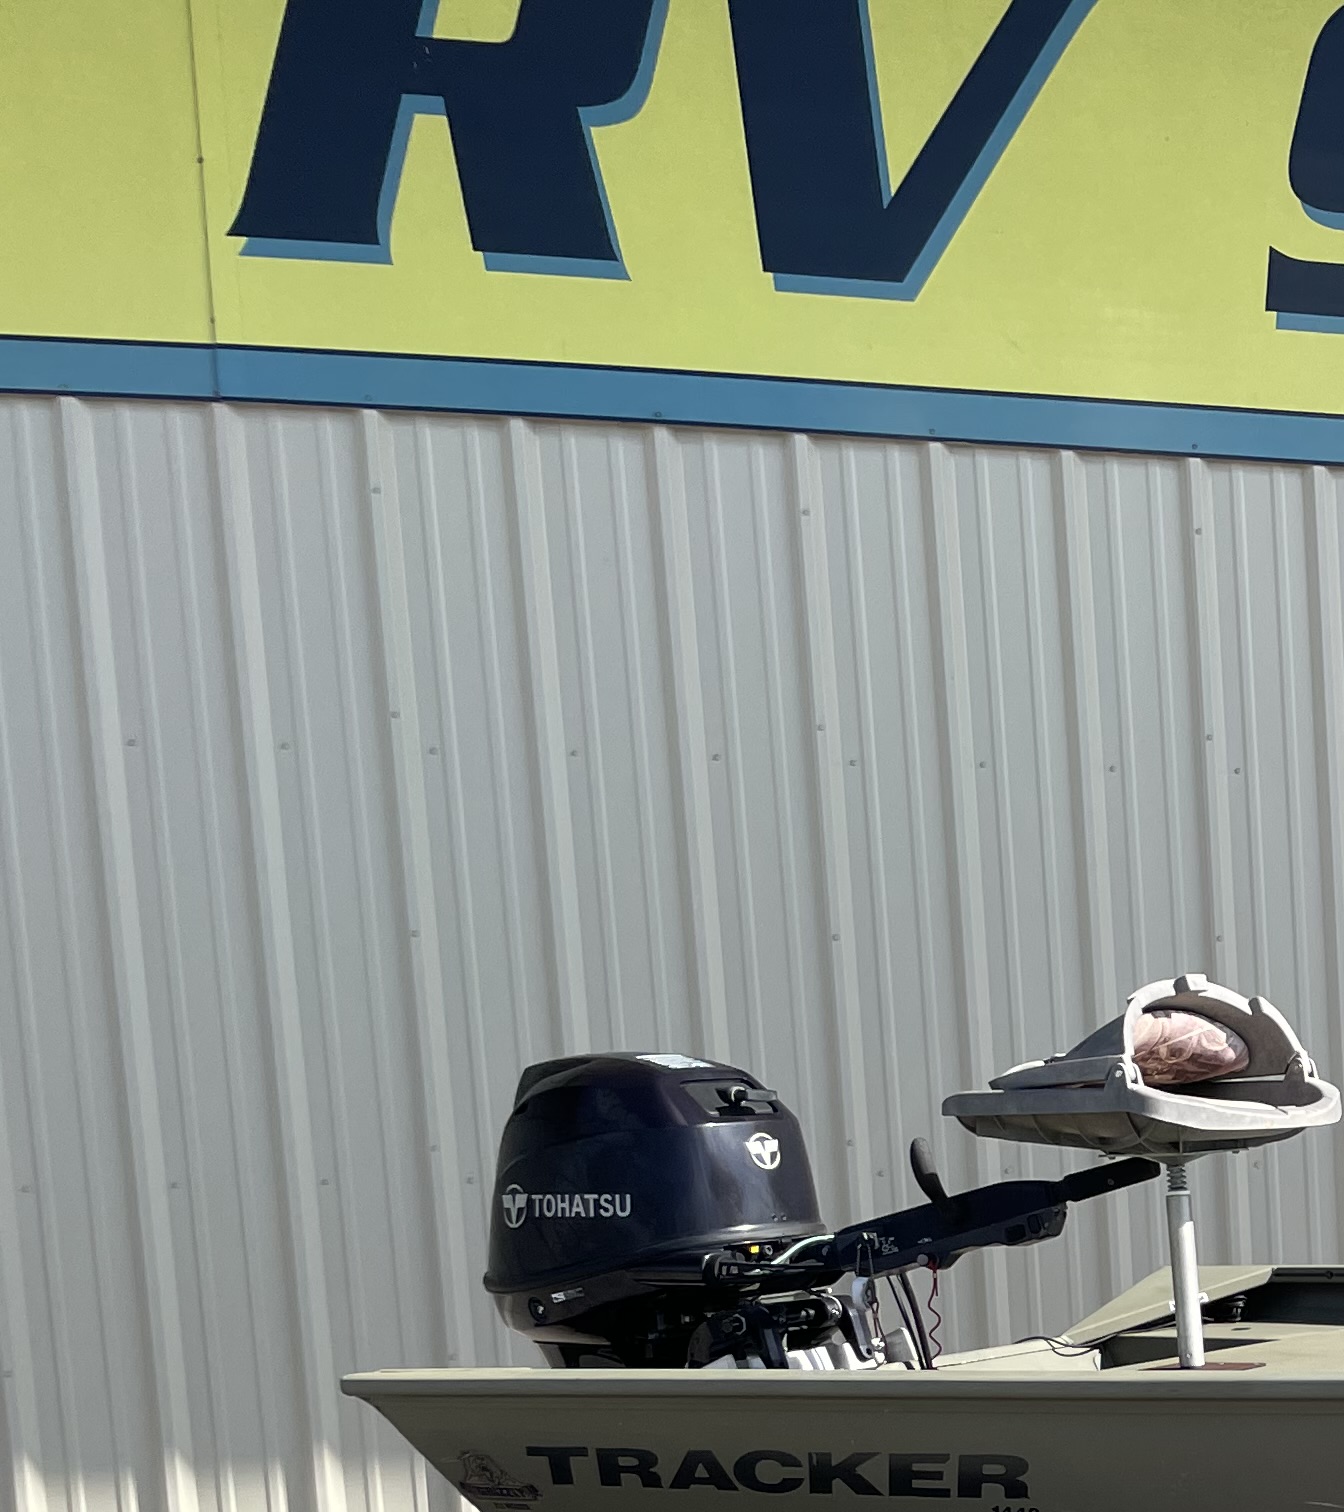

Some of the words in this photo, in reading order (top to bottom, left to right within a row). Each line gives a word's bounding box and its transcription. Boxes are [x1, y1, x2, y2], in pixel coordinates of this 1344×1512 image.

[228, 0, 1097, 302] RV
[531, 1193, 632, 1218] TOHATSU
[526, 1446, 1030, 1499] TRACKER
